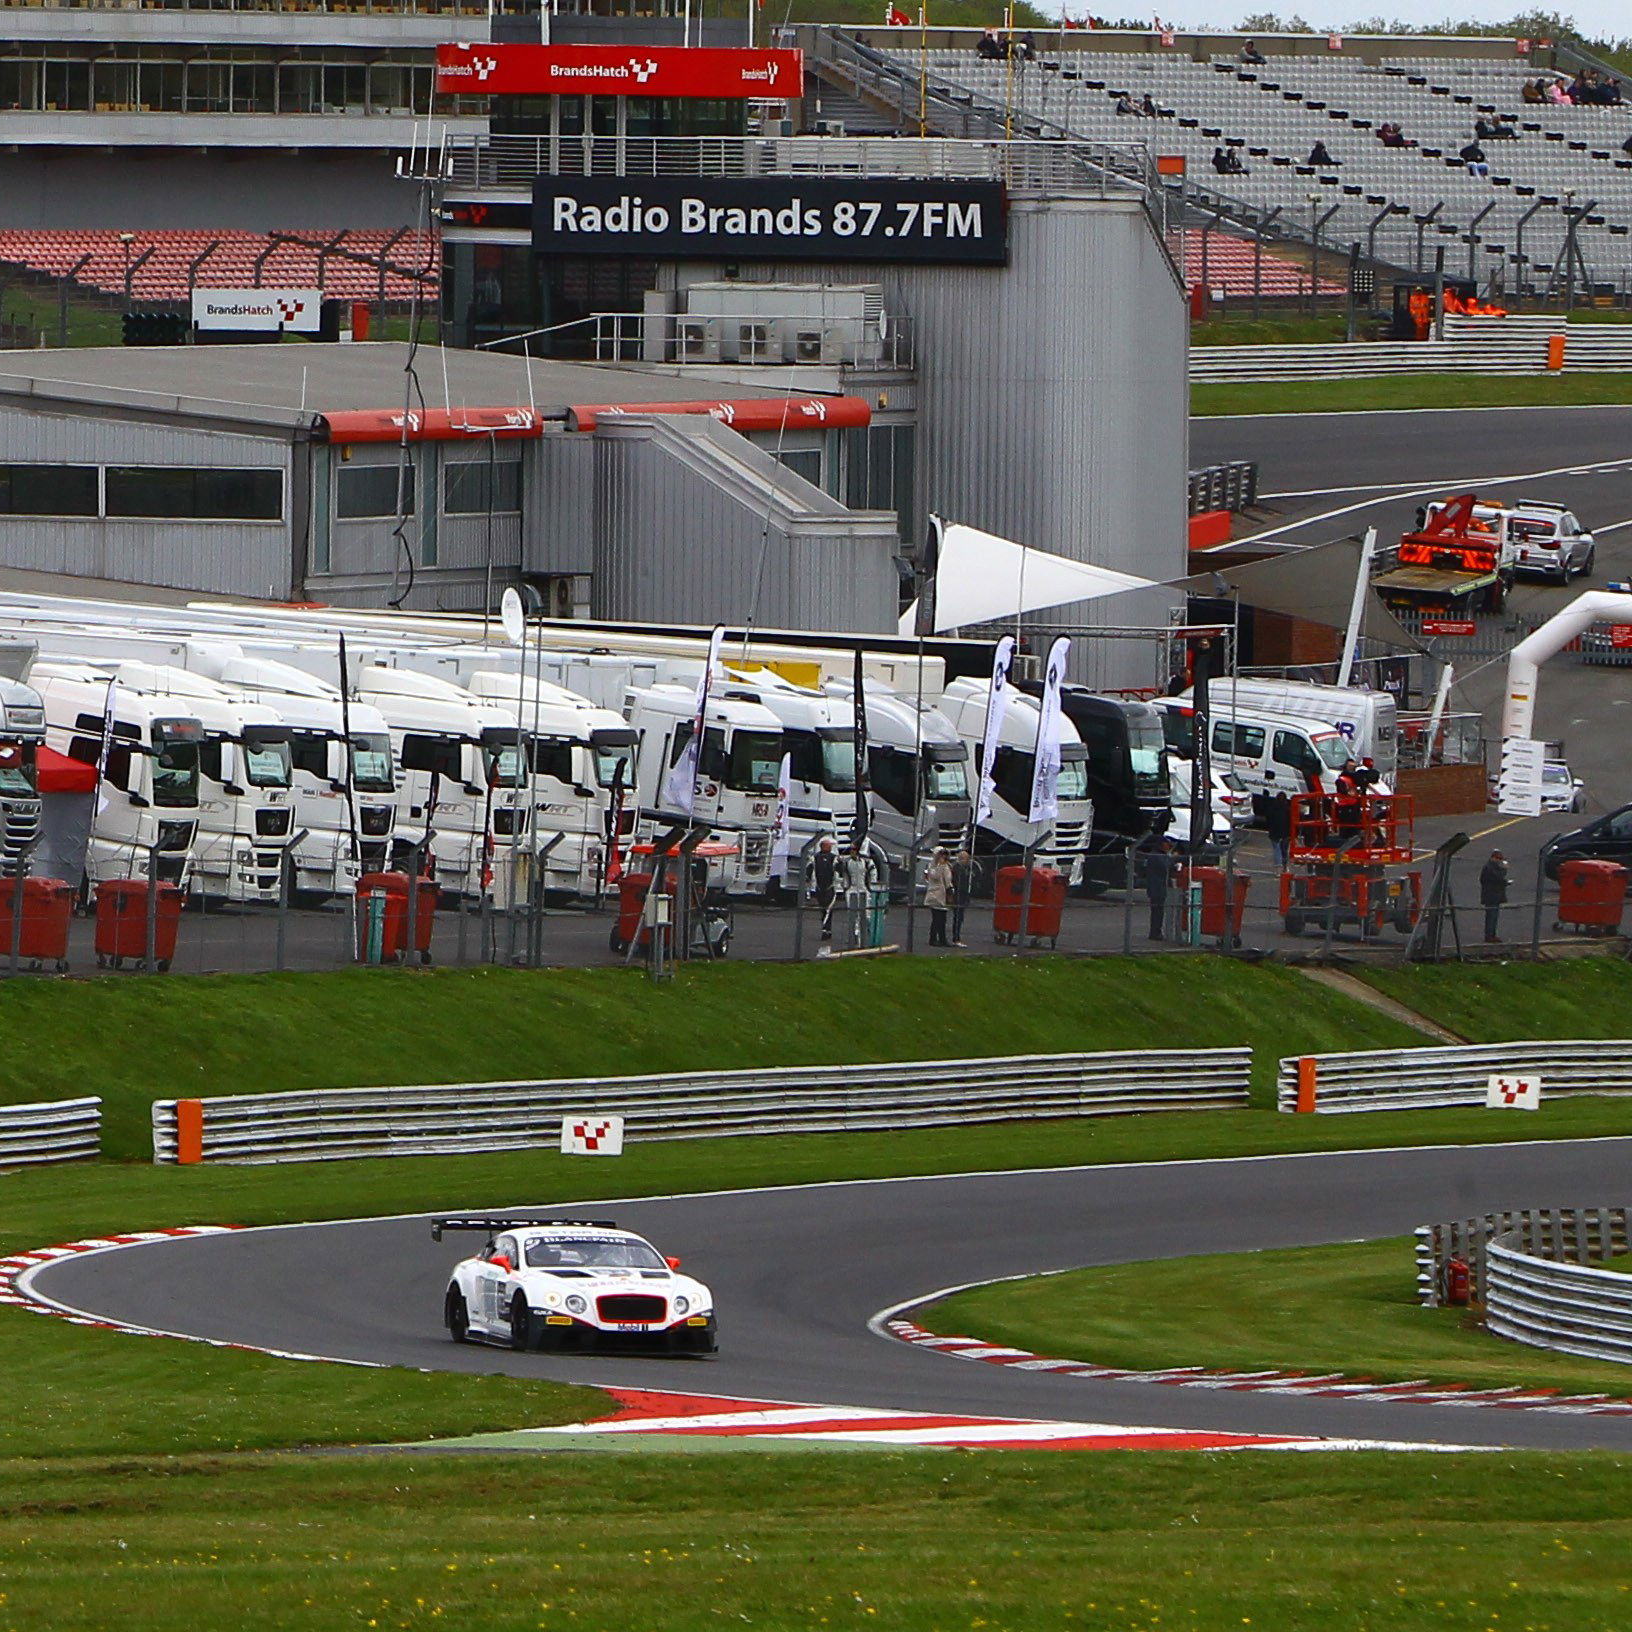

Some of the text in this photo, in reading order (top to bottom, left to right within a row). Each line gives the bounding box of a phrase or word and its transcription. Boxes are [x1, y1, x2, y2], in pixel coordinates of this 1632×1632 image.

[550, 65, 629, 78] BrandsHatch
[552, 197, 983, 238] Radio Brands 87.7FM
[207, 305, 273, 316] BrandsHatch
[543, 1236, 627, 1245] BLANCPAIN
